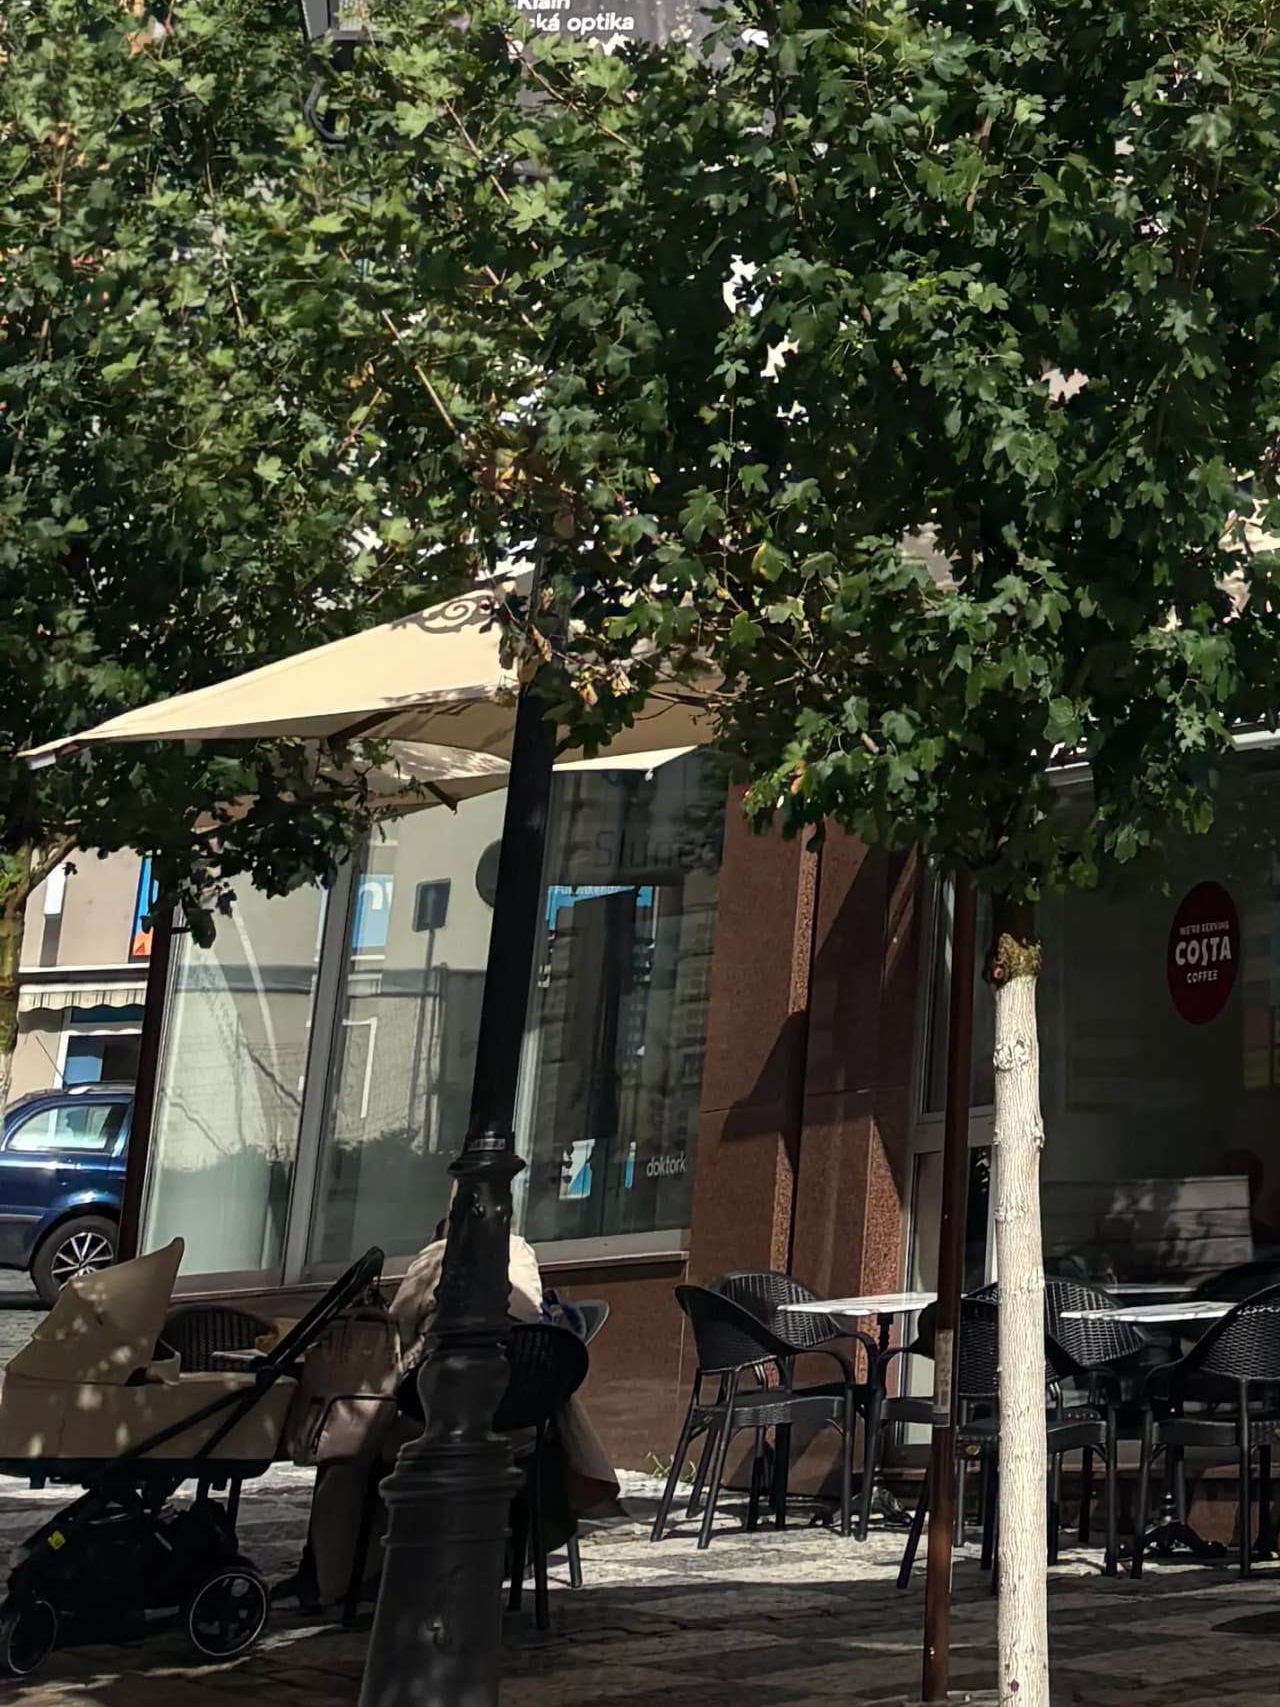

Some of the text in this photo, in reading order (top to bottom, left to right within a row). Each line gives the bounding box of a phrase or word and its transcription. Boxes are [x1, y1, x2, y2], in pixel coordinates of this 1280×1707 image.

[567, 13, 635, 36] optika
[1175, 935, 1233, 967] COSTA
[1186, 969, 1219, 984] COFFEE
